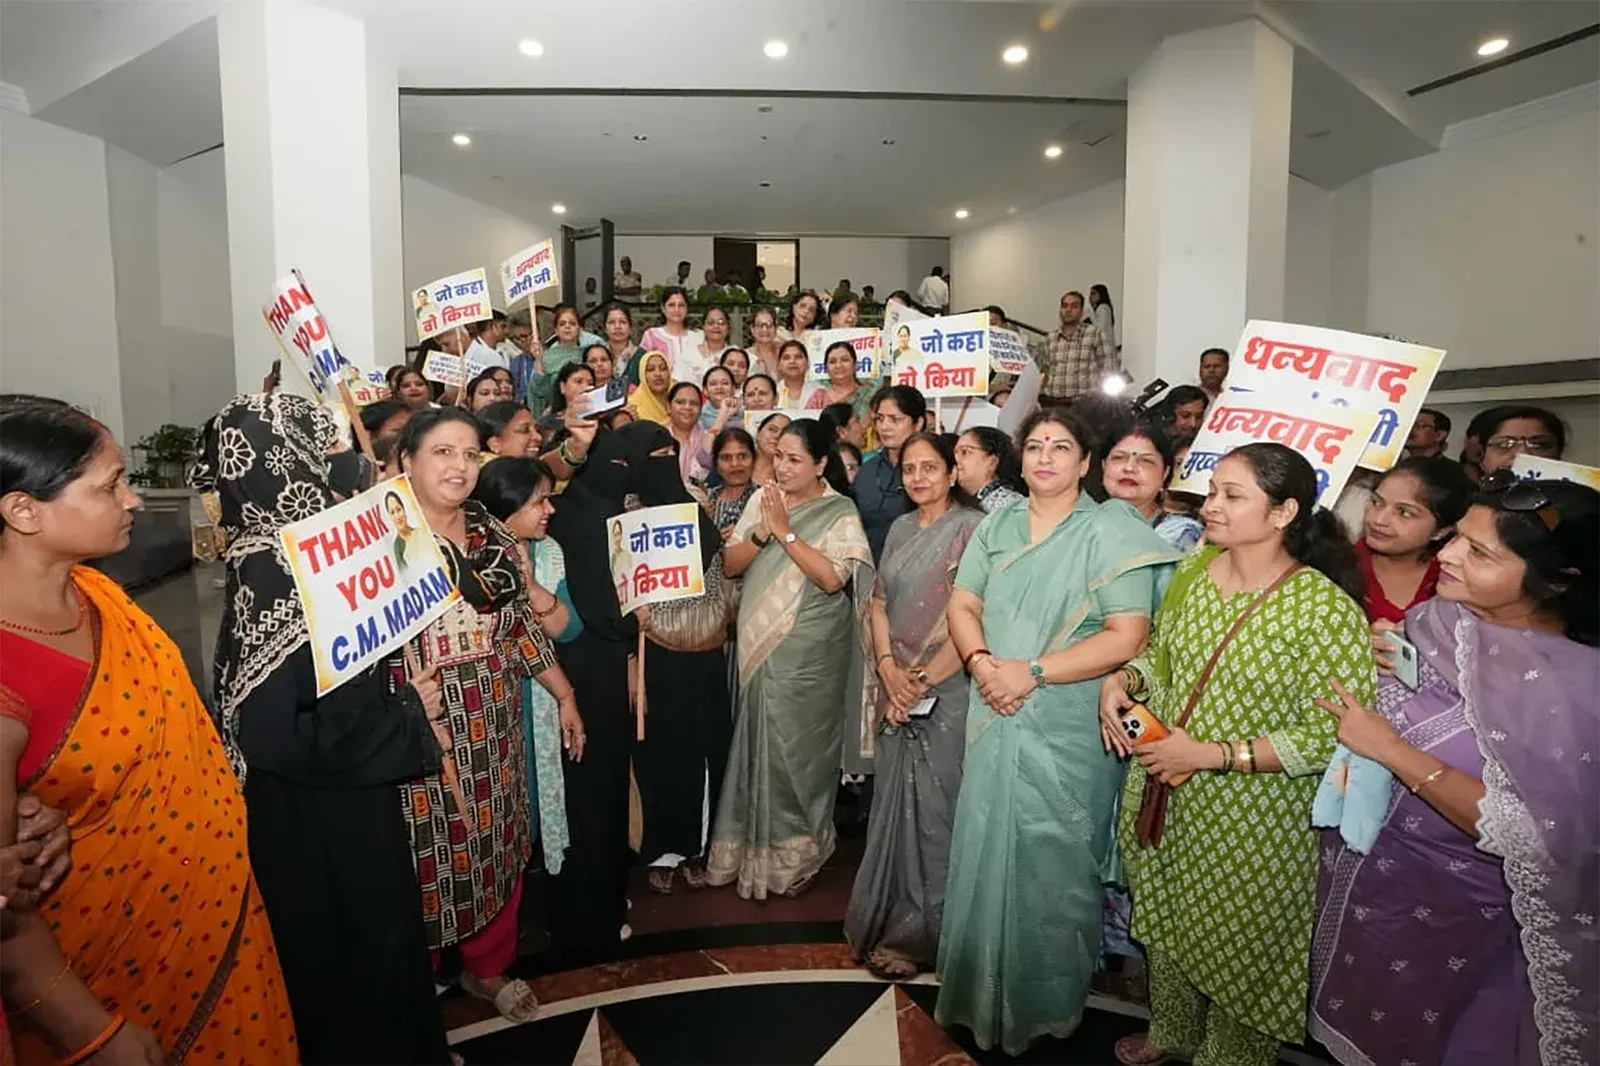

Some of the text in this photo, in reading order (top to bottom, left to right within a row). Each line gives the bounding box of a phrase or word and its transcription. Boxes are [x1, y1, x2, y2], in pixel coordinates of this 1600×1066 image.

[516, 248, 550, 276] धन्यवाद
[435, 279, 484, 302] जो कहा
[269, 283, 314, 335] THAN
[422, 302, 481, 333] वो किया
[920, 328, 943, 353] जो
[947, 329, 984, 352] कहा
[924, 362, 976, 389] किया
[1244, 336, 1417, 403] धन्यवाद
[1207, 406, 1353, 464] धन्यवाद
[298, 504, 389, 574] THANK
[630, 522, 694, 553] जो कहा
[336, 554, 395, 612] YOU
[634, 563, 690, 598] किया
[331, 566, 453, 671] C.M. MADAM
